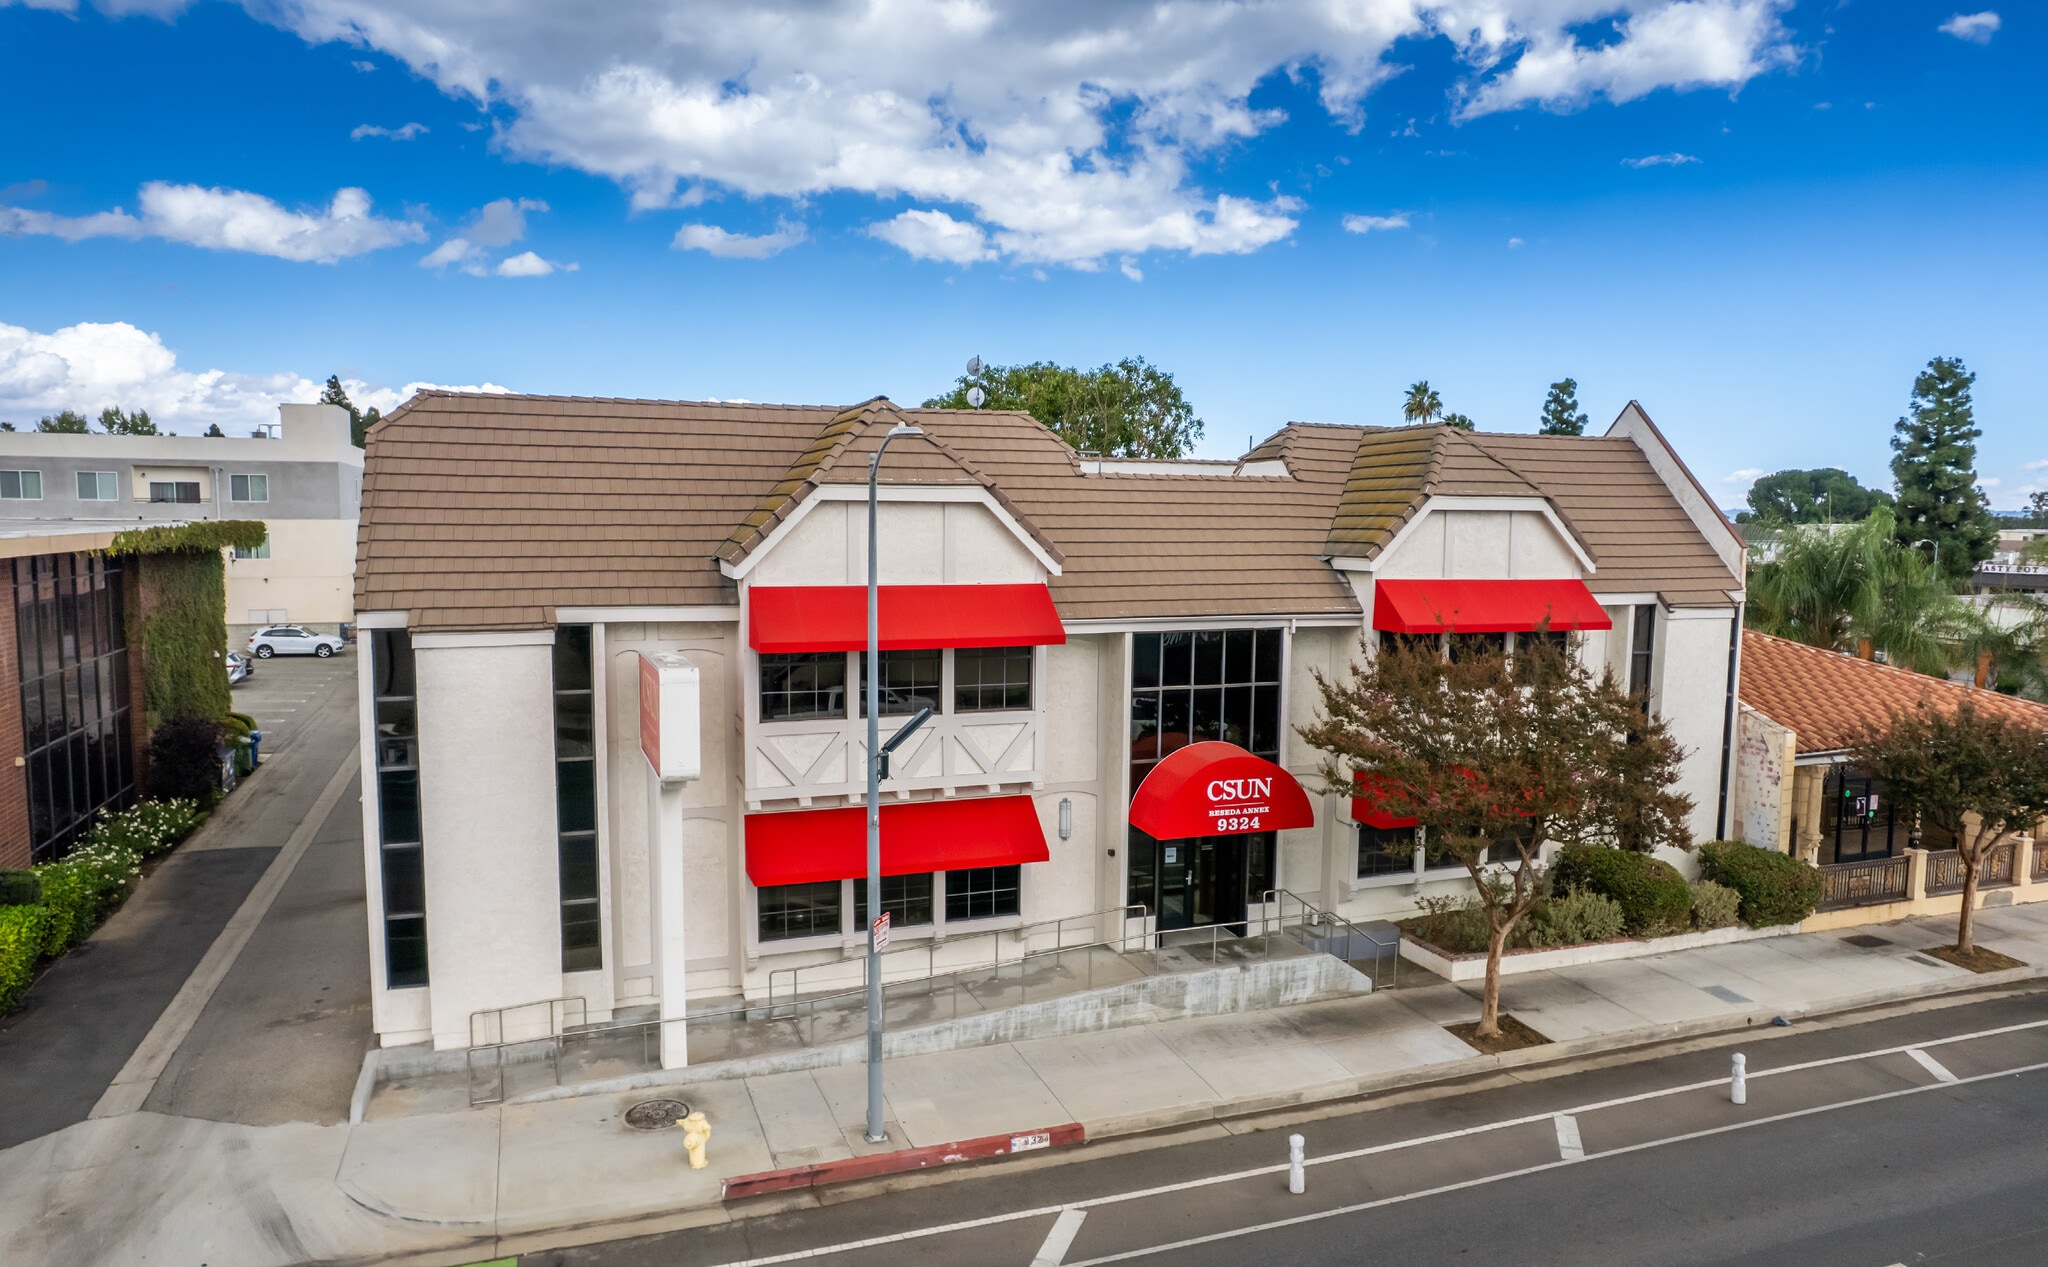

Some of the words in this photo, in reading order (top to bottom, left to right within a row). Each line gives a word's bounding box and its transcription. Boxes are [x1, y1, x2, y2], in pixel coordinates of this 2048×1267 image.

[1207, 777, 1273, 802] CSUN
[1209, 808, 1241, 817] RESEDA
[1242, 806, 1270, 815] ANNEX
[1217, 816, 1260, 832] 9324
